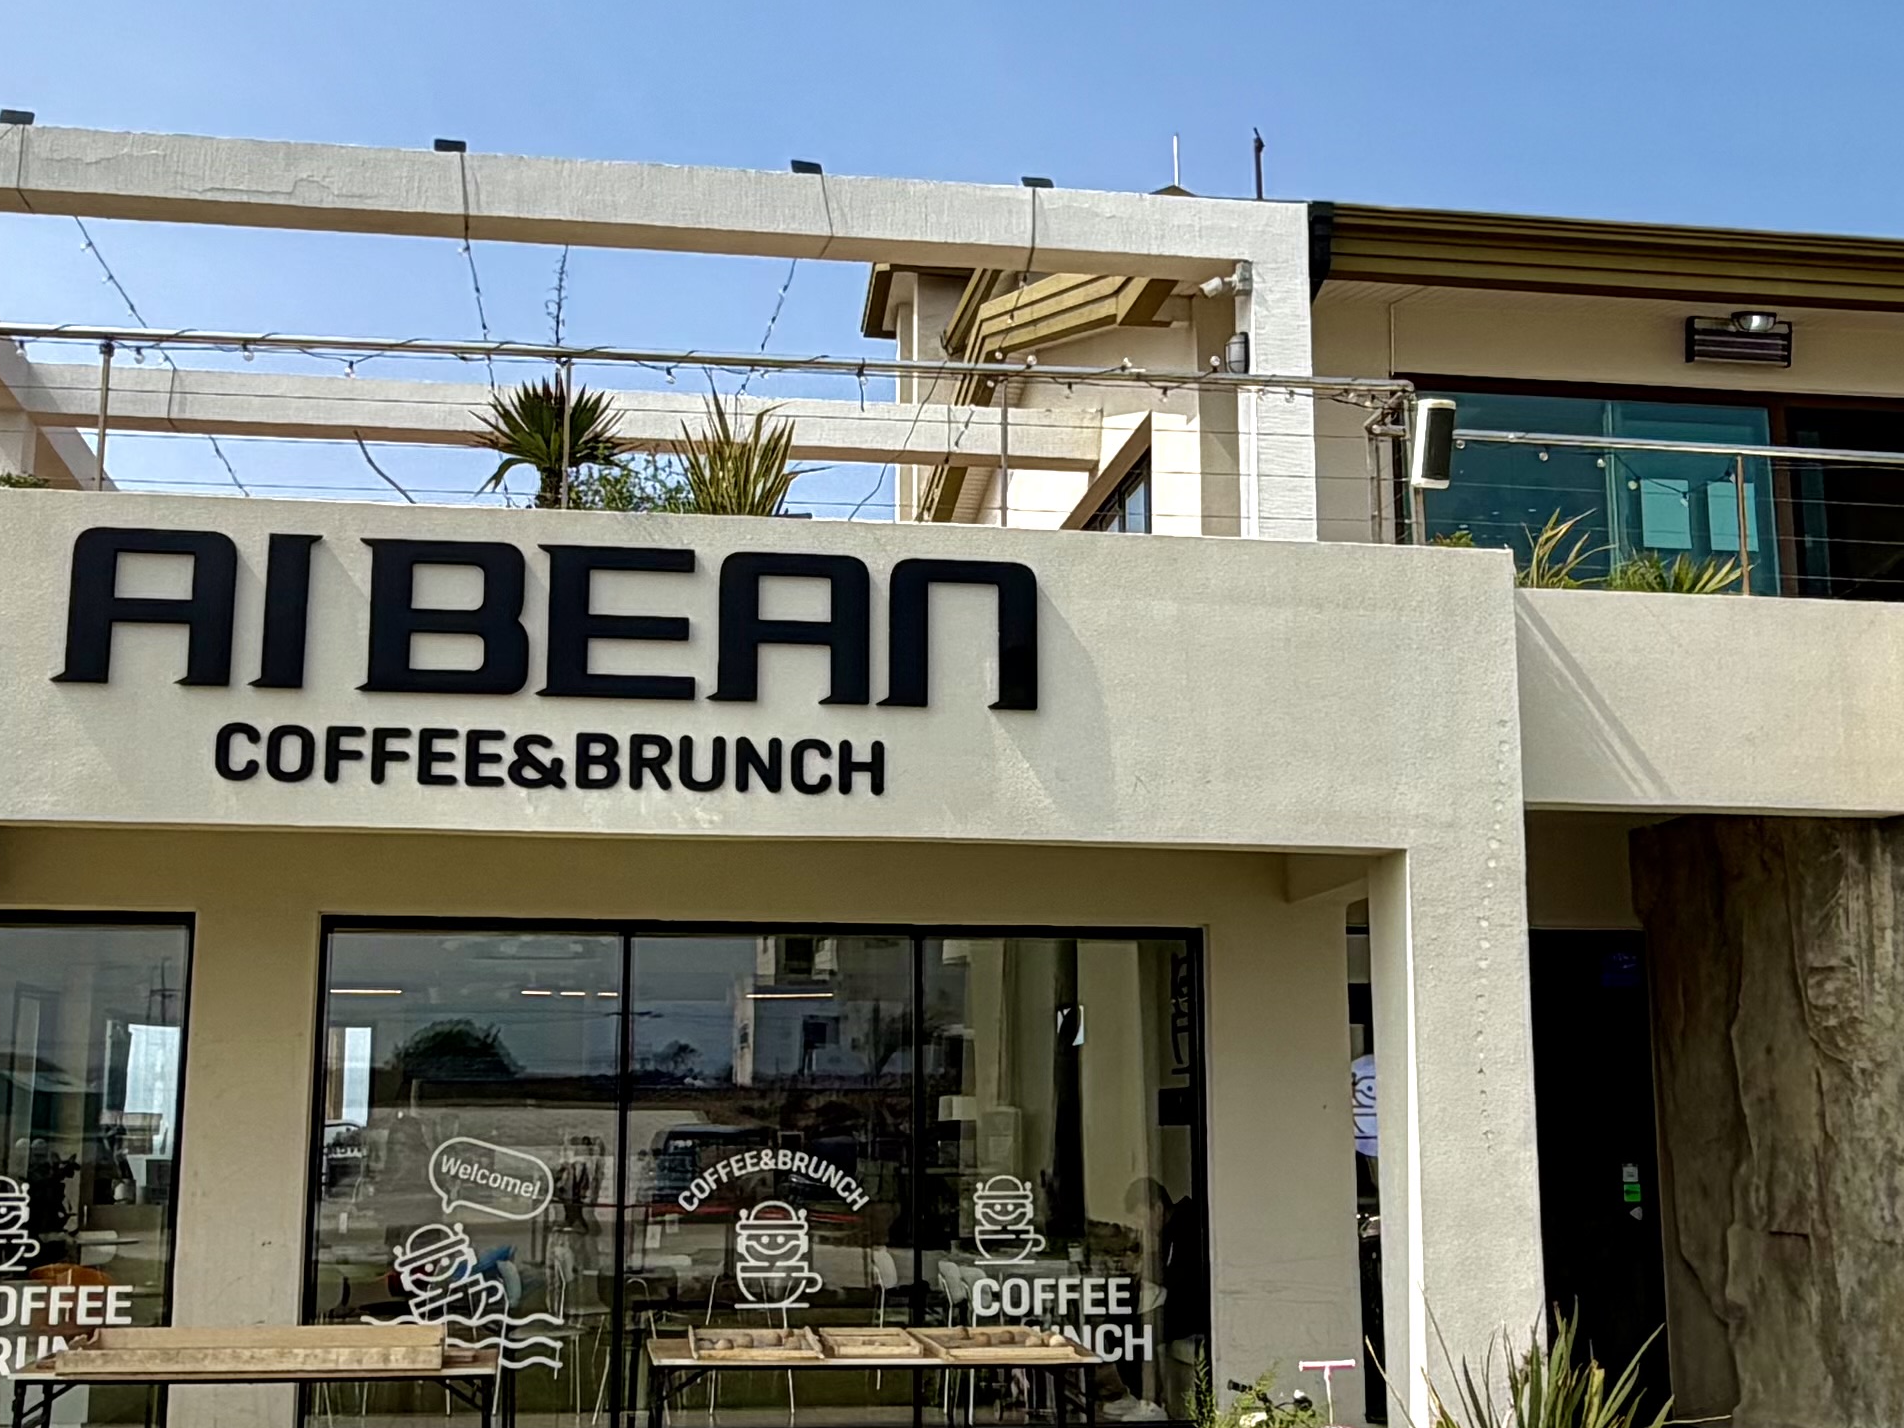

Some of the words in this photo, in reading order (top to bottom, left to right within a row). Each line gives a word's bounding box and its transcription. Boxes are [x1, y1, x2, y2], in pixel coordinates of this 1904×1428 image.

[355, 537, 1039, 712] BEAN
[213, 721, 886, 798] COFFEE&BRUNCH
[440, 1154, 542, 1201] Welcome!
[677, 1148, 871, 1212] COFFEE&BRUNCH
[972, 1276, 1133, 1317] COFFEE
